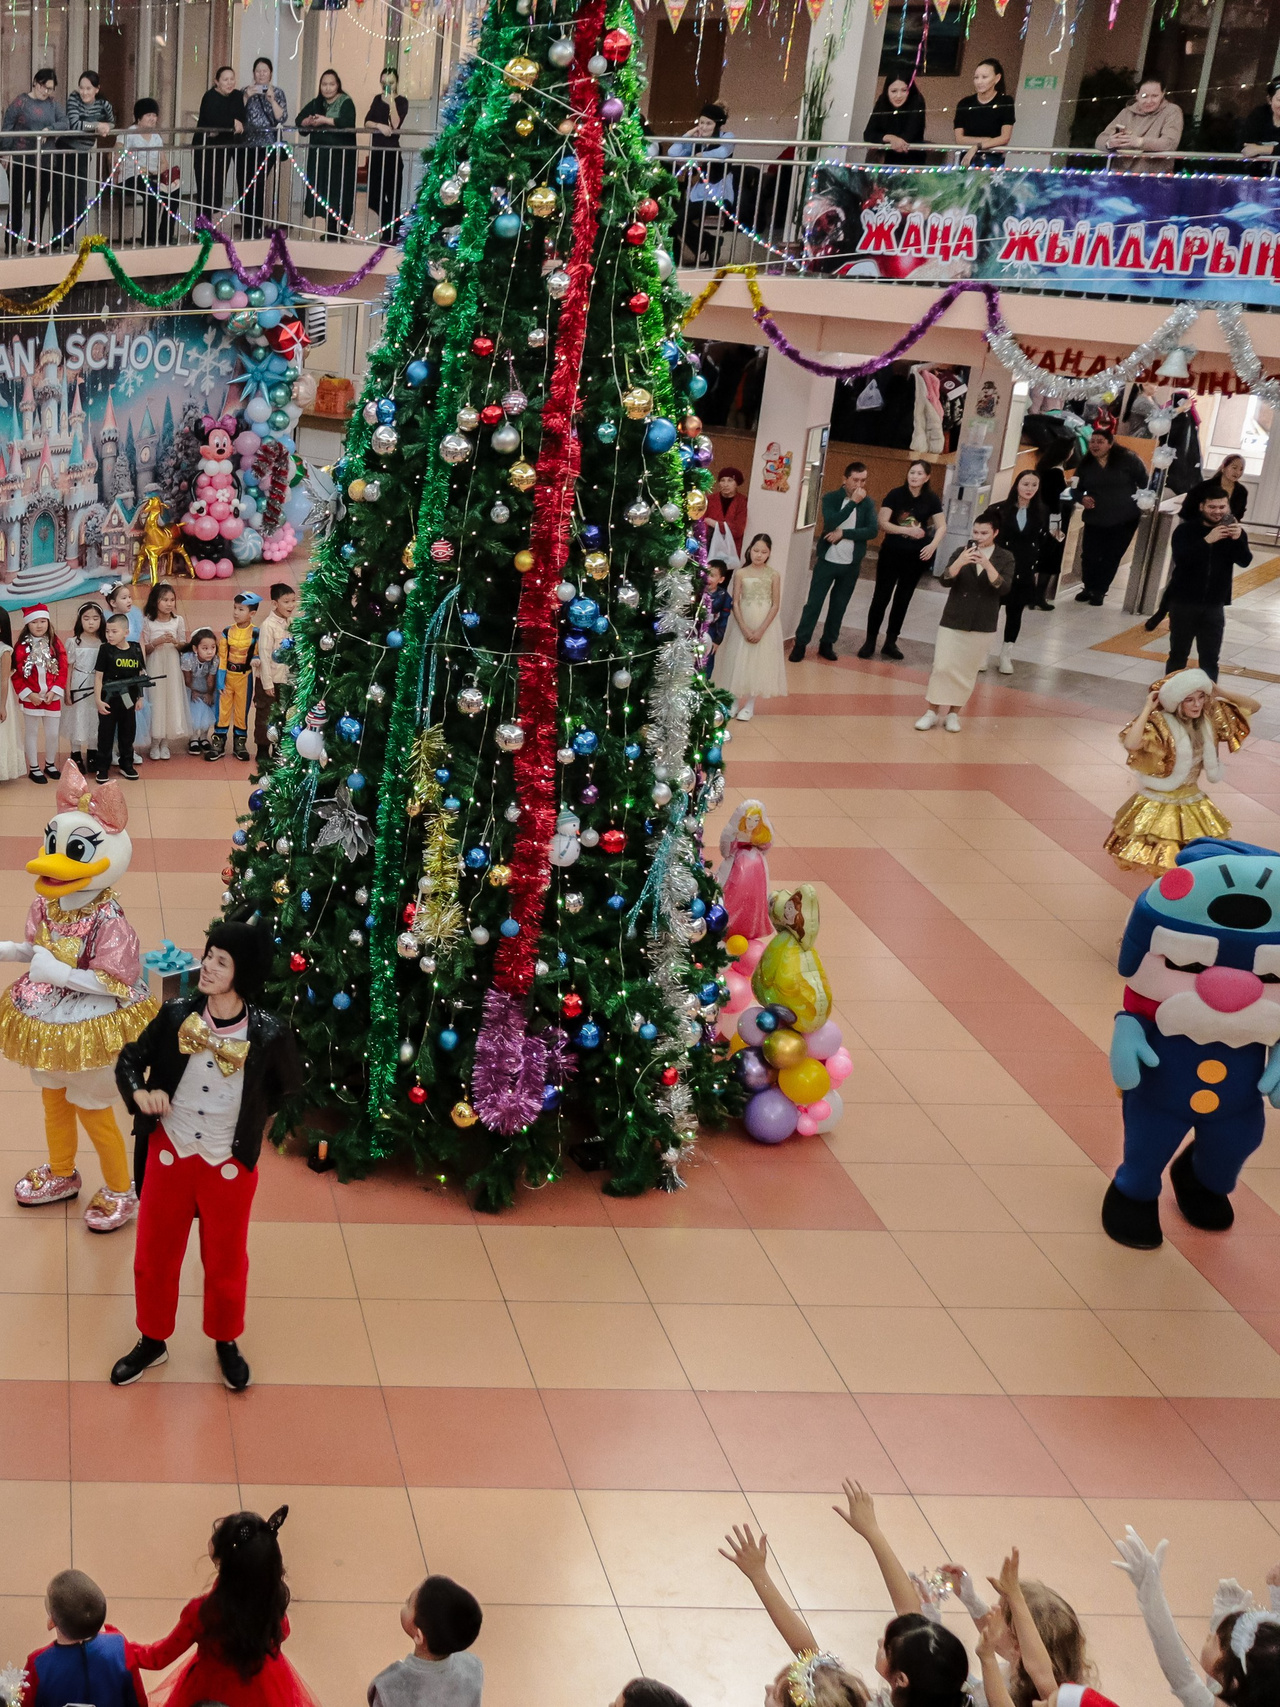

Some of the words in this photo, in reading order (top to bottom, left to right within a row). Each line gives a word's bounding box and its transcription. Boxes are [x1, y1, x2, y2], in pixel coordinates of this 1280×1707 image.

[856, 208, 977, 266] ЖАҢА
[65, 332, 191, 378] SCHOOL
[115, 658, 139, 668] ОМОН
